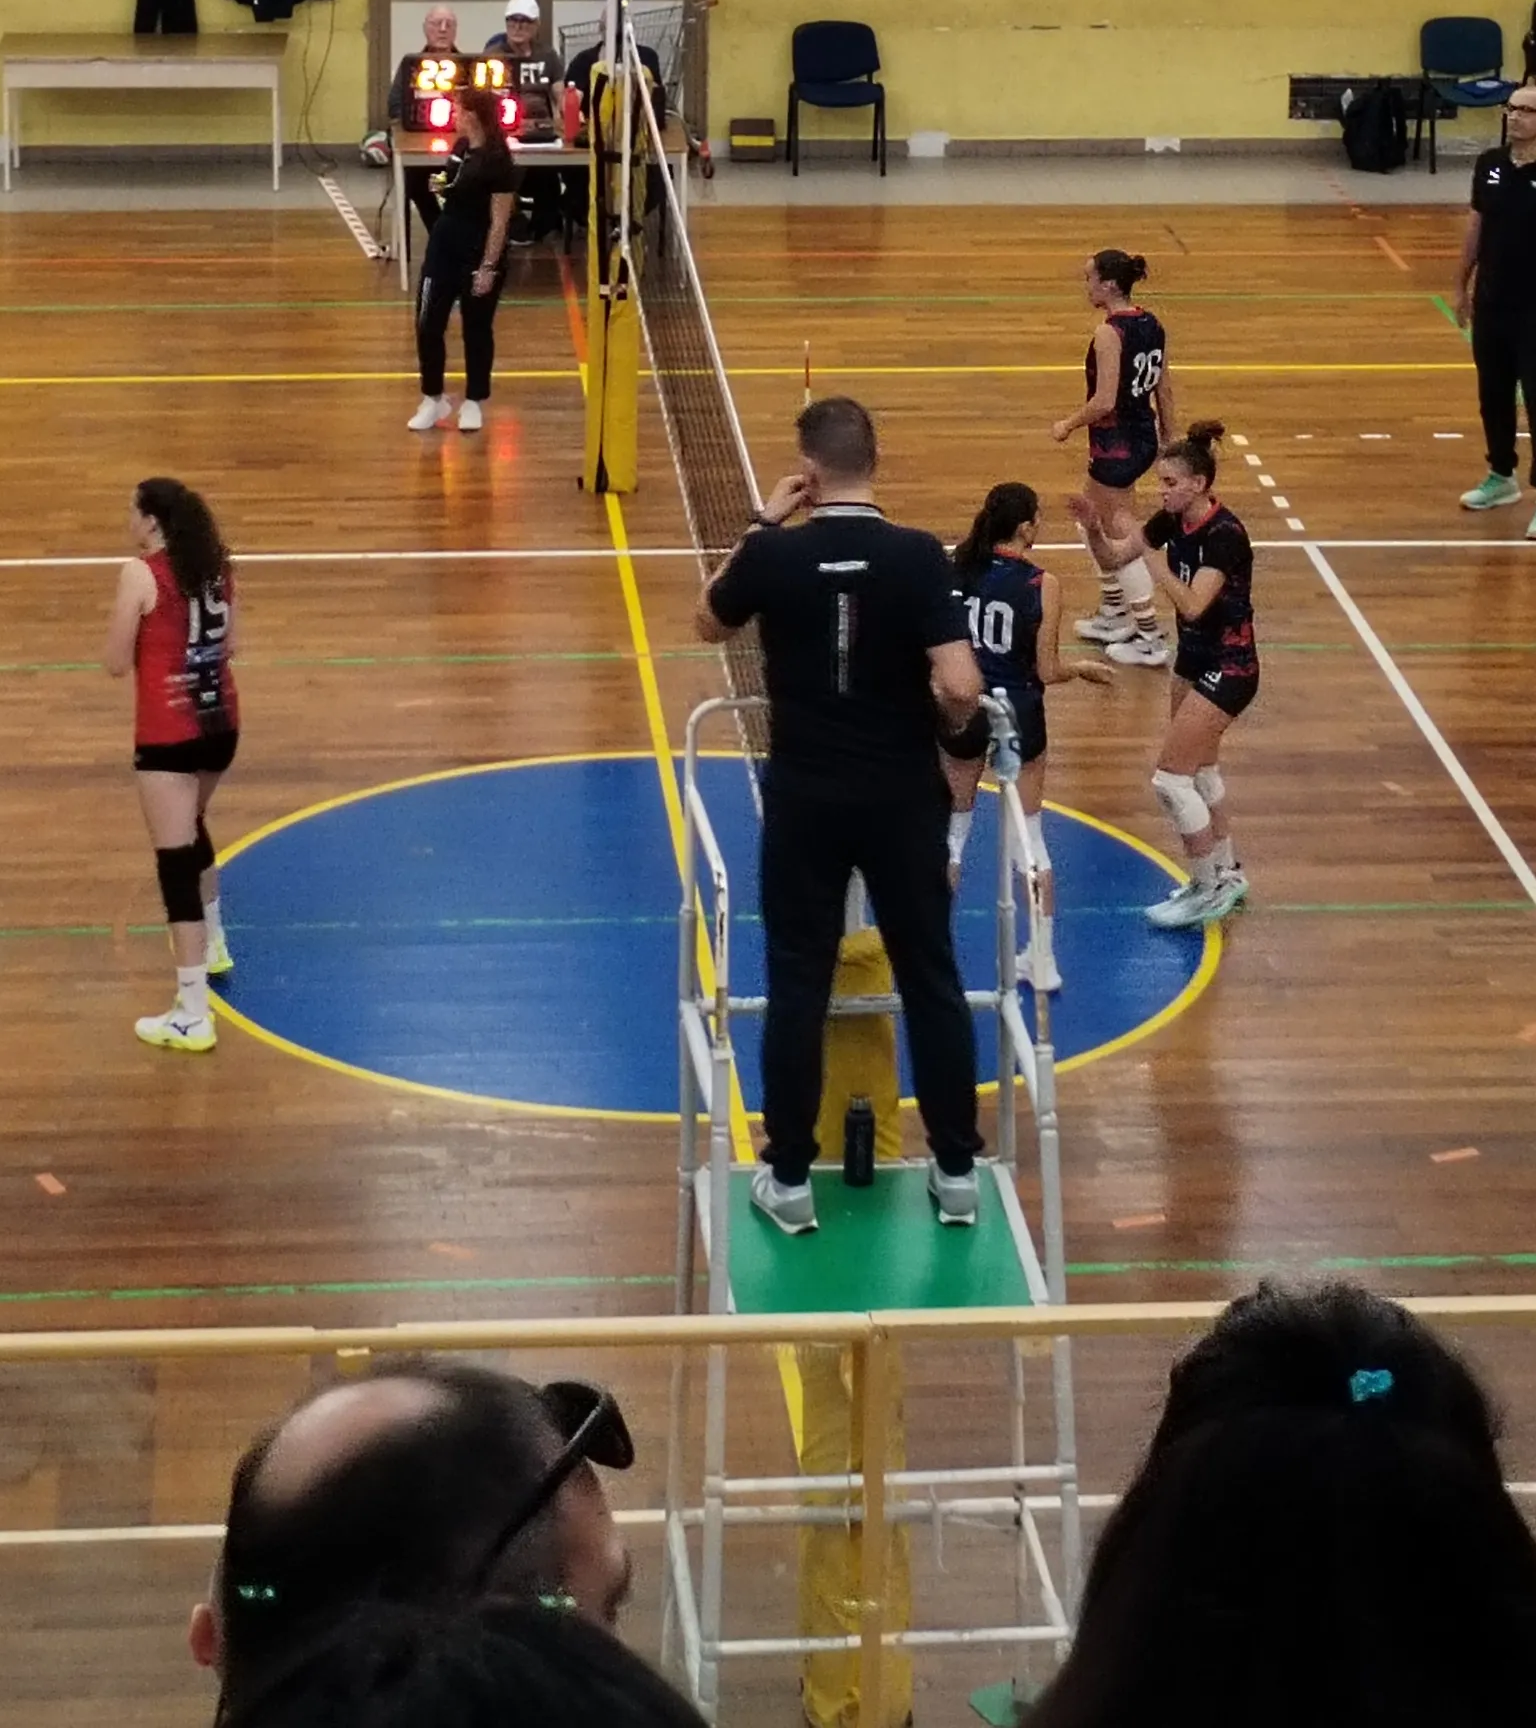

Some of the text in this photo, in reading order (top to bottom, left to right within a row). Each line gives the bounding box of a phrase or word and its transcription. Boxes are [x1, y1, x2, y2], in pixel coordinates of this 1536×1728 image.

[417, 58, 457, 91] 22
[474, 58, 505, 89] 17
[188, 574, 229, 644] 15
[964, 595, 1014, 654] 10
